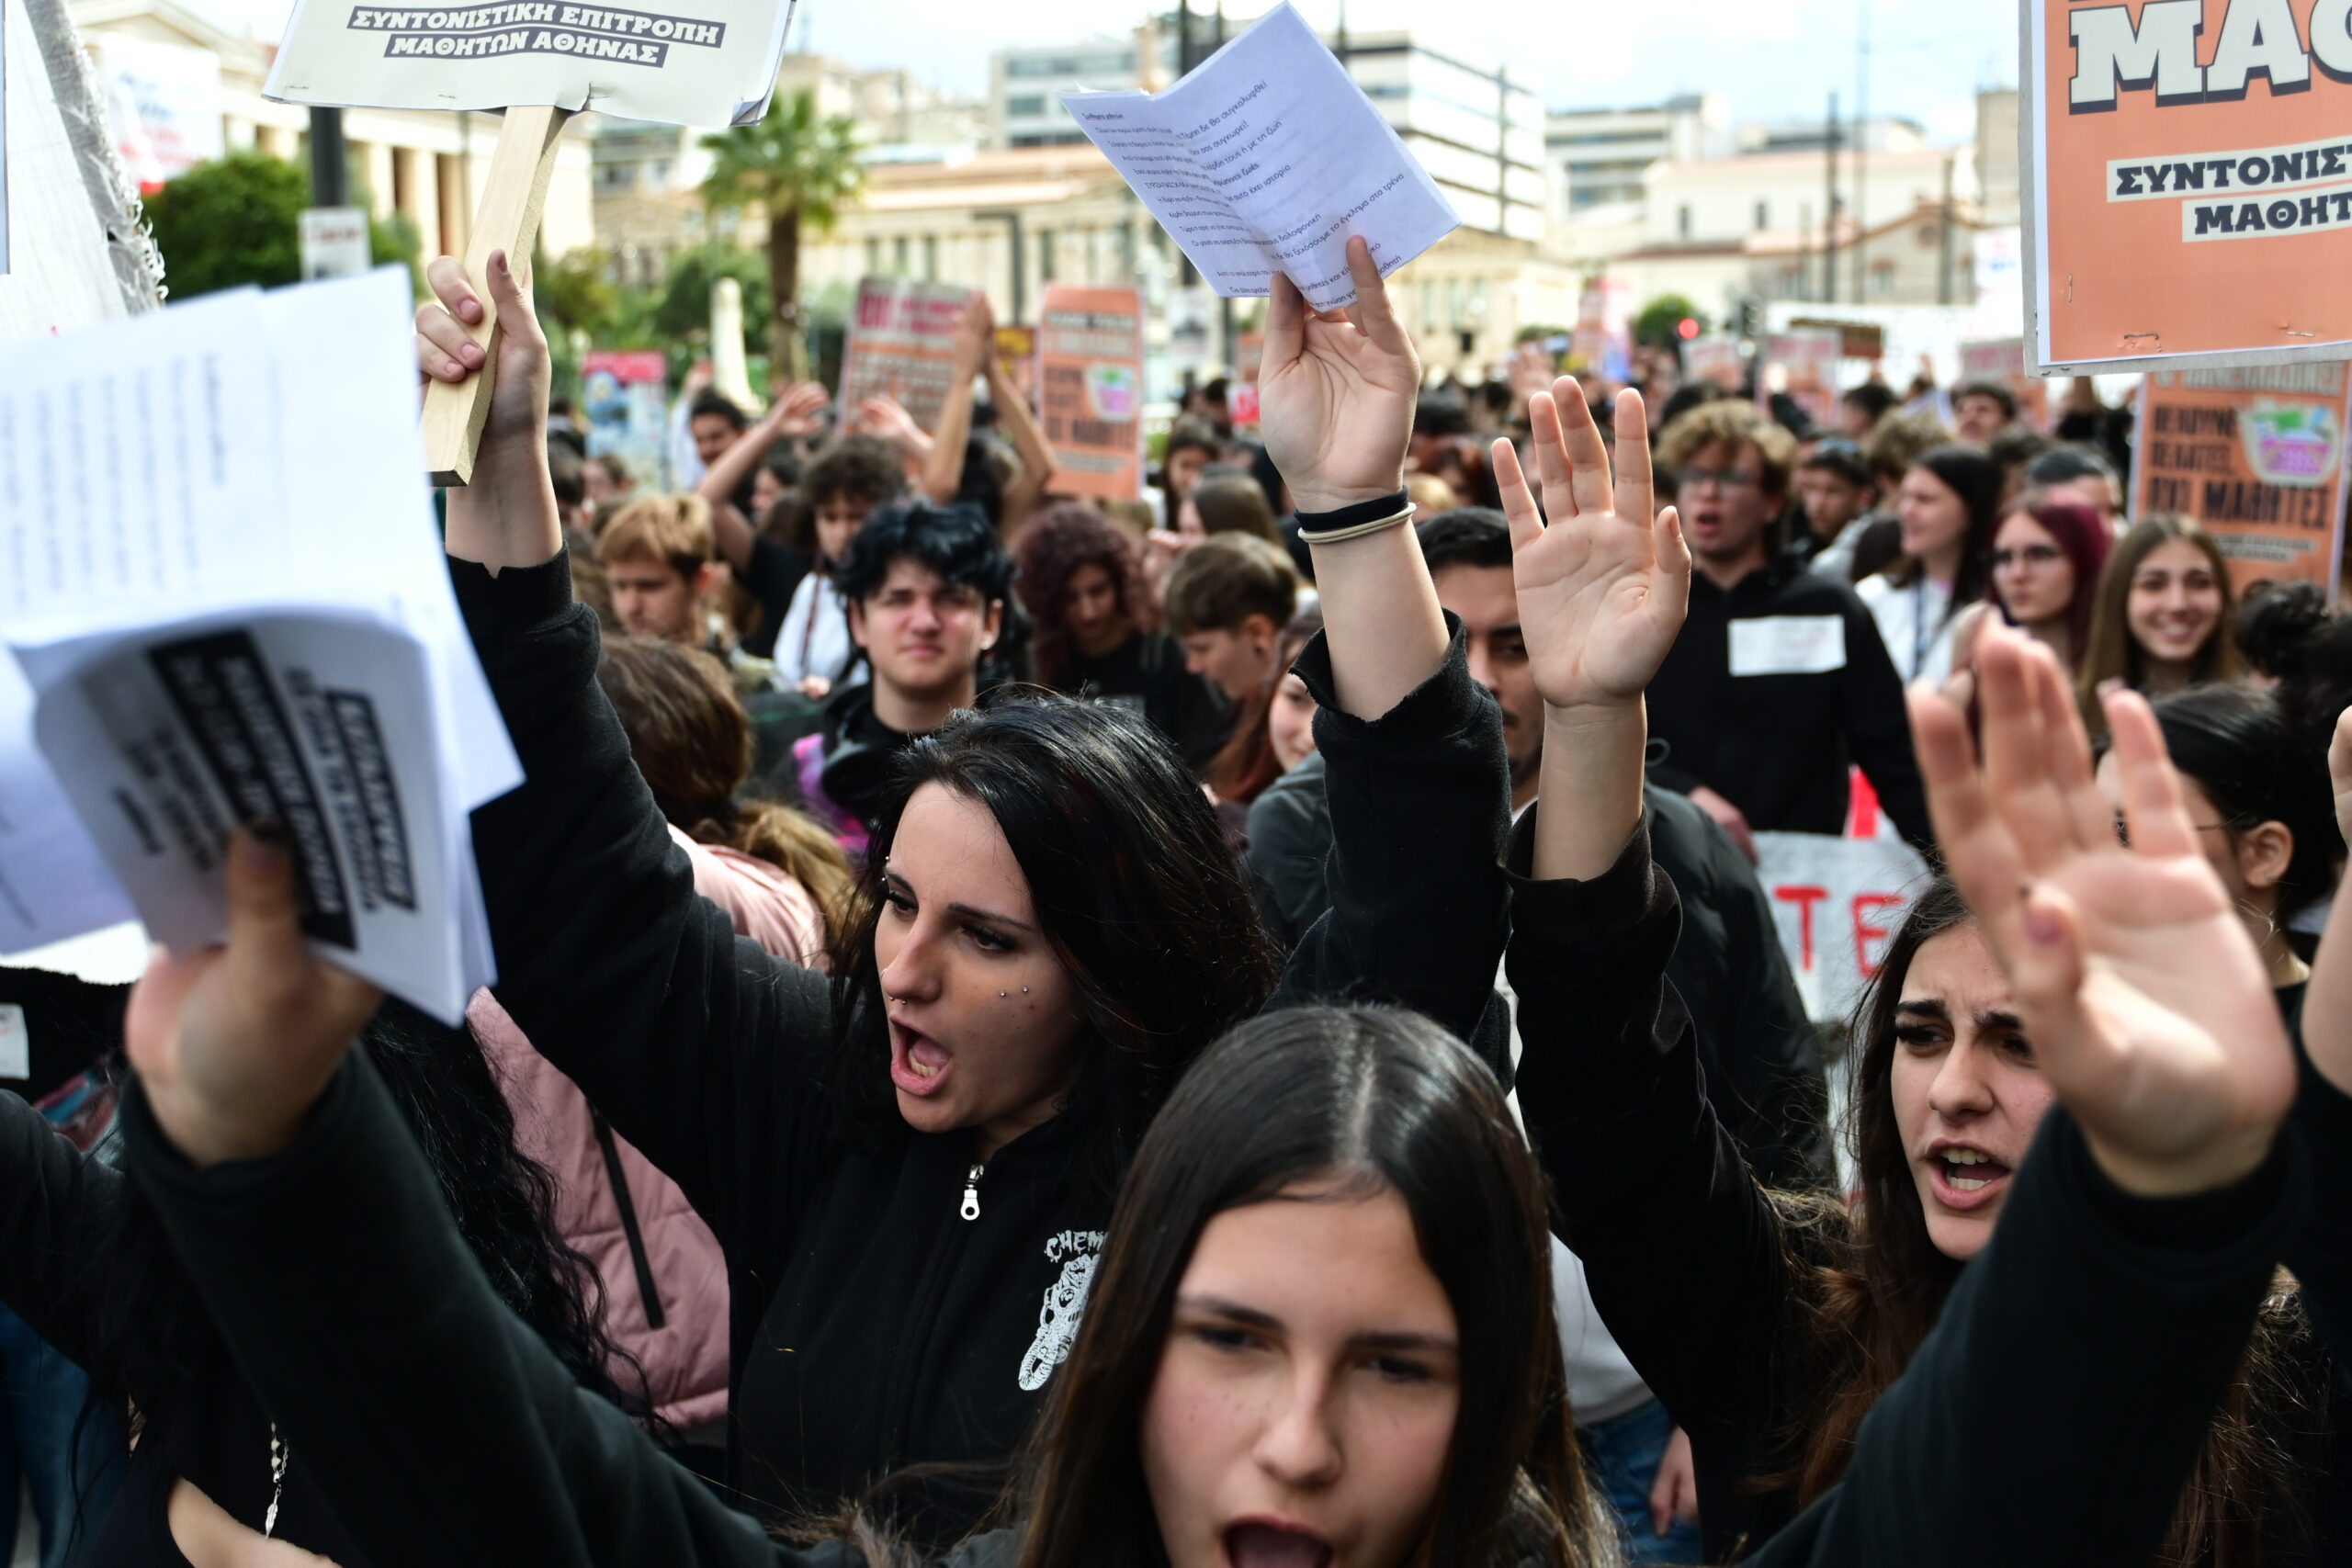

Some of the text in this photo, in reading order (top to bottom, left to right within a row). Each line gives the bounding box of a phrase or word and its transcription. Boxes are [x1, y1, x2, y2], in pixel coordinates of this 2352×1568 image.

[353, 3, 719, 45] ΣΥΝΤΟΝΙΣΤΙΚΗ ΕΠΙΤΡΟΠΗ
[390, 30, 661, 63] ΜΑΘΗΤΩΝ ΑΘΗΝΑΣ
[1209, 117, 1221, 127] θα
[1221, 79, 1268, 119] συγκαλυφθεί
[1225, 152, 1241, 164] τους
[1249, 141, 1257, 152] με
[1258, 133, 1267, 141] τη
[1263, 164, 1292, 186] ιστορία
[2116, 144, 2352, 196] ΣΥΝΤΟΝΙΣ
[1331, 222, 1340, 232] το
[1340, 199, 1370, 225] έγκλημα
[1369, 189, 1384, 202] στα
[1383, 173, 1405, 193] τρένα
[1278, 213, 1322, 242] δολοφονική
[1329, 273, 1342, 283] και
[1044, 1230, 1110, 1263] CHEM
